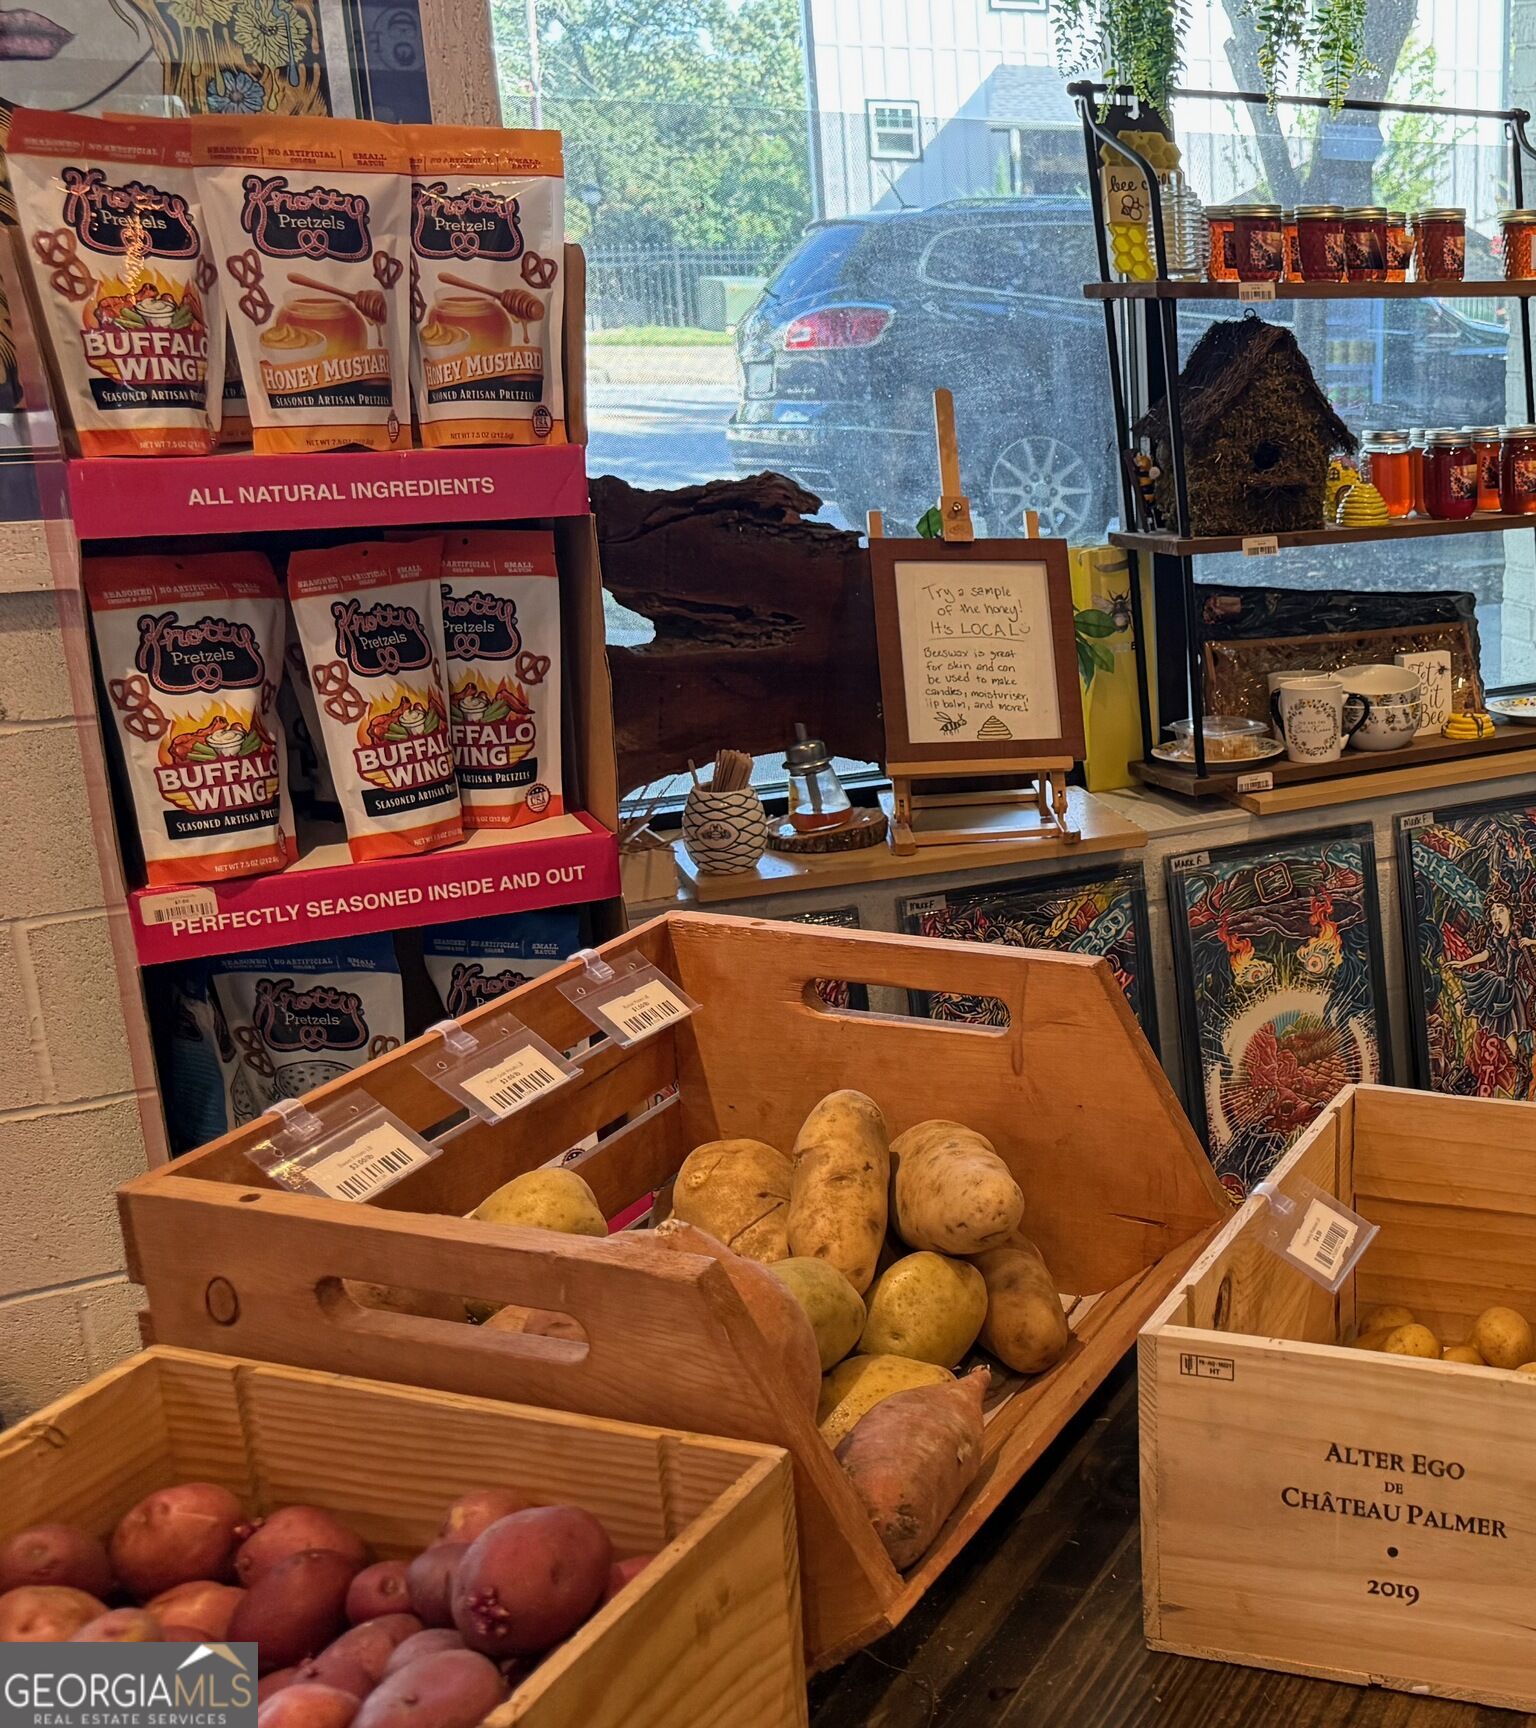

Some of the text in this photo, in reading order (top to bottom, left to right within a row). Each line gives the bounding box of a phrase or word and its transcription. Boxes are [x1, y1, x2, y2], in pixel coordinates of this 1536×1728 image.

[352, 152, 388, 161] SMALL
[1109, 175, 1138, 193] bee
[245, 177, 366, 228] Knotty
[278, 214, 346, 230] Pretzels
[434, 217, 496, 232] Pretzels
[114, 357, 197, 380] WING
[264, 364, 319, 391] HONEY
[426, 351, 543, 386] HONEY MUSTARD
[102, 390, 148, 403] SEASONED
[276, 395, 315, 408] SEASONED
[318, 393, 356, 406] ARTISAN
[460, 388, 496, 400] ARTISAN
[189, 476, 495, 506] ALL NATURAL INGREDIENTS
[922, 583, 1012, 604] Try a sample
[937, 599, 1024, 623] of the honey!
[930, 620, 1020, 637] It's LOCAL
[140, 614, 251, 668] Knotty
[359, 630, 407, 651] Pretzels
[171, 648, 236, 666] Pretzels
[924, 646, 1016, 661] Beeswax is great
[926, 659, 1016, 673] for skin and can
[1408, 661, 1437, 688] Let
[926, 671, 1018, 687] be used to make
[974, 699, 994, 710] and
[998, 702, 1030, 713] more!
[1428, 687, 1445, 709] it
[1419, 704, 1446, 729] Bee
[384, 757, 449, 788] WING
[463, 771, 531, 784] ARTISAN PRETZELS
[188, 779, 266, 811] WING
[375, 793, 416, 810] SEASONED
[418, 787, 445, 802] ARTISAN
[176, 817, 221, 833] SEASONED
[224, 812, 259, 827] ARTISAN
[172, 864, 587, 937] PERFECTLY SEASONED INSIDE AND OUT
[285, 1013, 341, 1026] Pretzels
[1324, 1442, 1466, 1480] ALTER EGO
[1384, 1481, 1404, 1495] DE
[1281, 1486, 1509, 1539] CHÂTEAU PALMER
[1367, 1579, 1420, 1607] 2019
